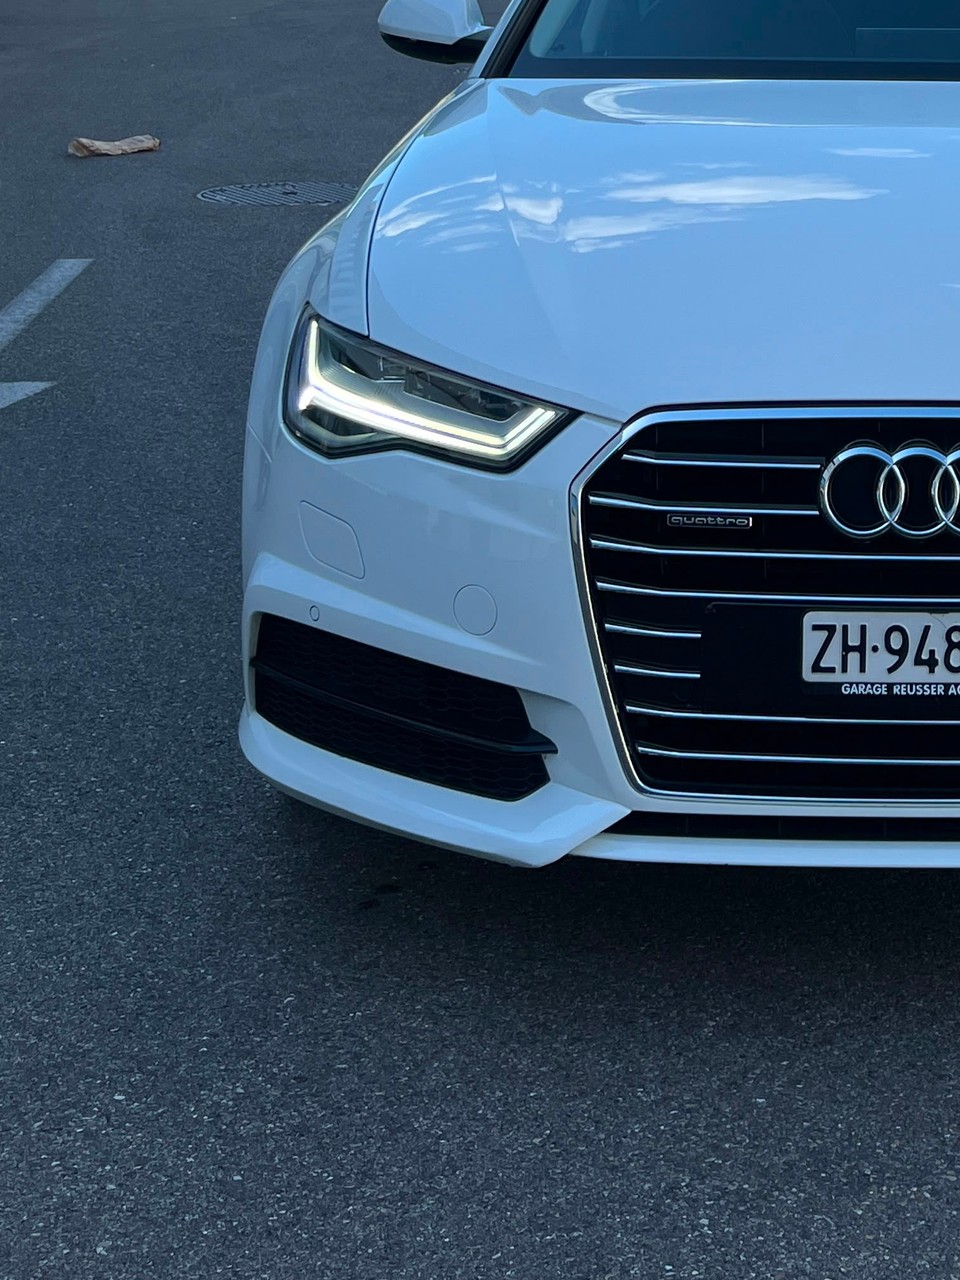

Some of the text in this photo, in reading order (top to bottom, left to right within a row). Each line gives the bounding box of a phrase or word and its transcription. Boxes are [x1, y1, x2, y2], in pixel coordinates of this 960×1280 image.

[671, 516, 748, 526] quattro
[841, 683, 888, 696] GARAGE
[893, 683, 945, 696] REUSSER
